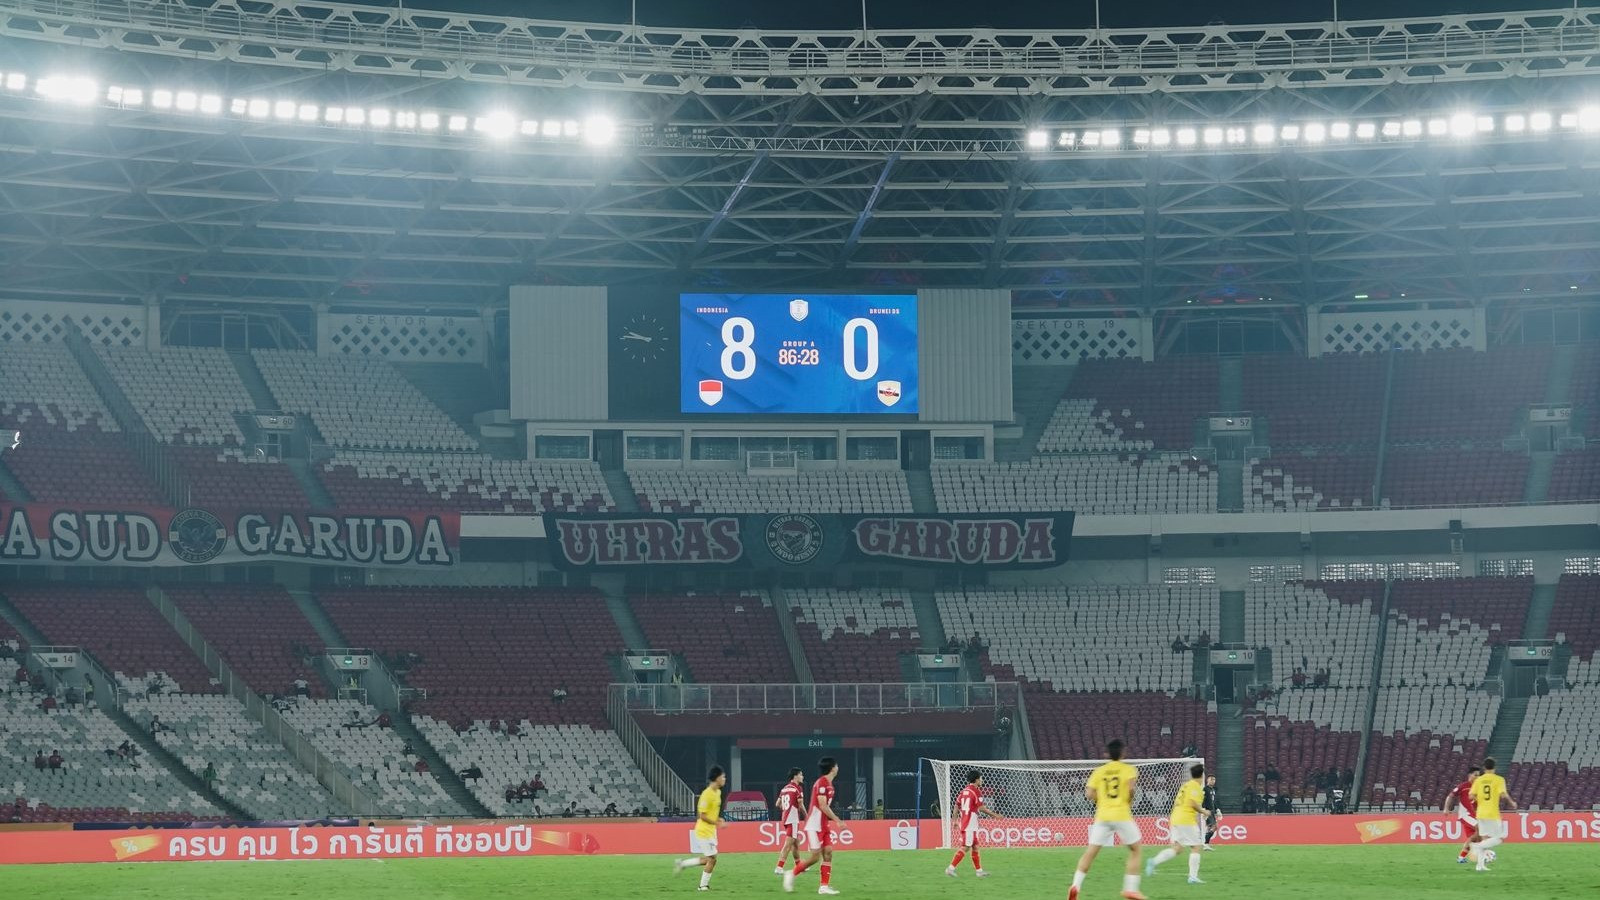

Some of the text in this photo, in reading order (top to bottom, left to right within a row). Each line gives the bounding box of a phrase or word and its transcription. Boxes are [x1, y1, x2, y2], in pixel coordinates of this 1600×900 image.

[355, 315, 427, 326] SEKTOR
[1015, 319, 1114, 330] SEKTOR 19
[720, 317, 756, 380] 8
[843, 317, 879, 381] 0
[778, 349, 819, 366] 86:28
[1240, 418, 1250, 427] 57
[50, 511, 160, 560] SUD
[236, 513, 452, 564] GARUDA
[556, 516, 743, 565] ULTRAS
[852, 517, 1056, 564] GARUDA
[63, 655, 73, 663] 14
[358, 657, 368, 665] 13
[951, 656, 959, 664] 11
[1243, 652, 1253, 660] 10
[1541, 649, 1552, 657] 09
[655, 658, 665, 666] 12
[808, 739, 823, 747] Exit
[1103, 776, 1120, 799] 13
[1483, 785, 1491, 801] 9
[781, 794, 791, 811] 18
[961, 797, 971, 815] 14
[1410, 820, 1461, 840] ครบ
[1518, 812, 1547, 839] ไว
[169, 836, 226, 857] ครบ
[288, 827, 318, 856] ไว
[329, 826, 424, 855] การันตี
[759, 822, 853, 851] Shoee
